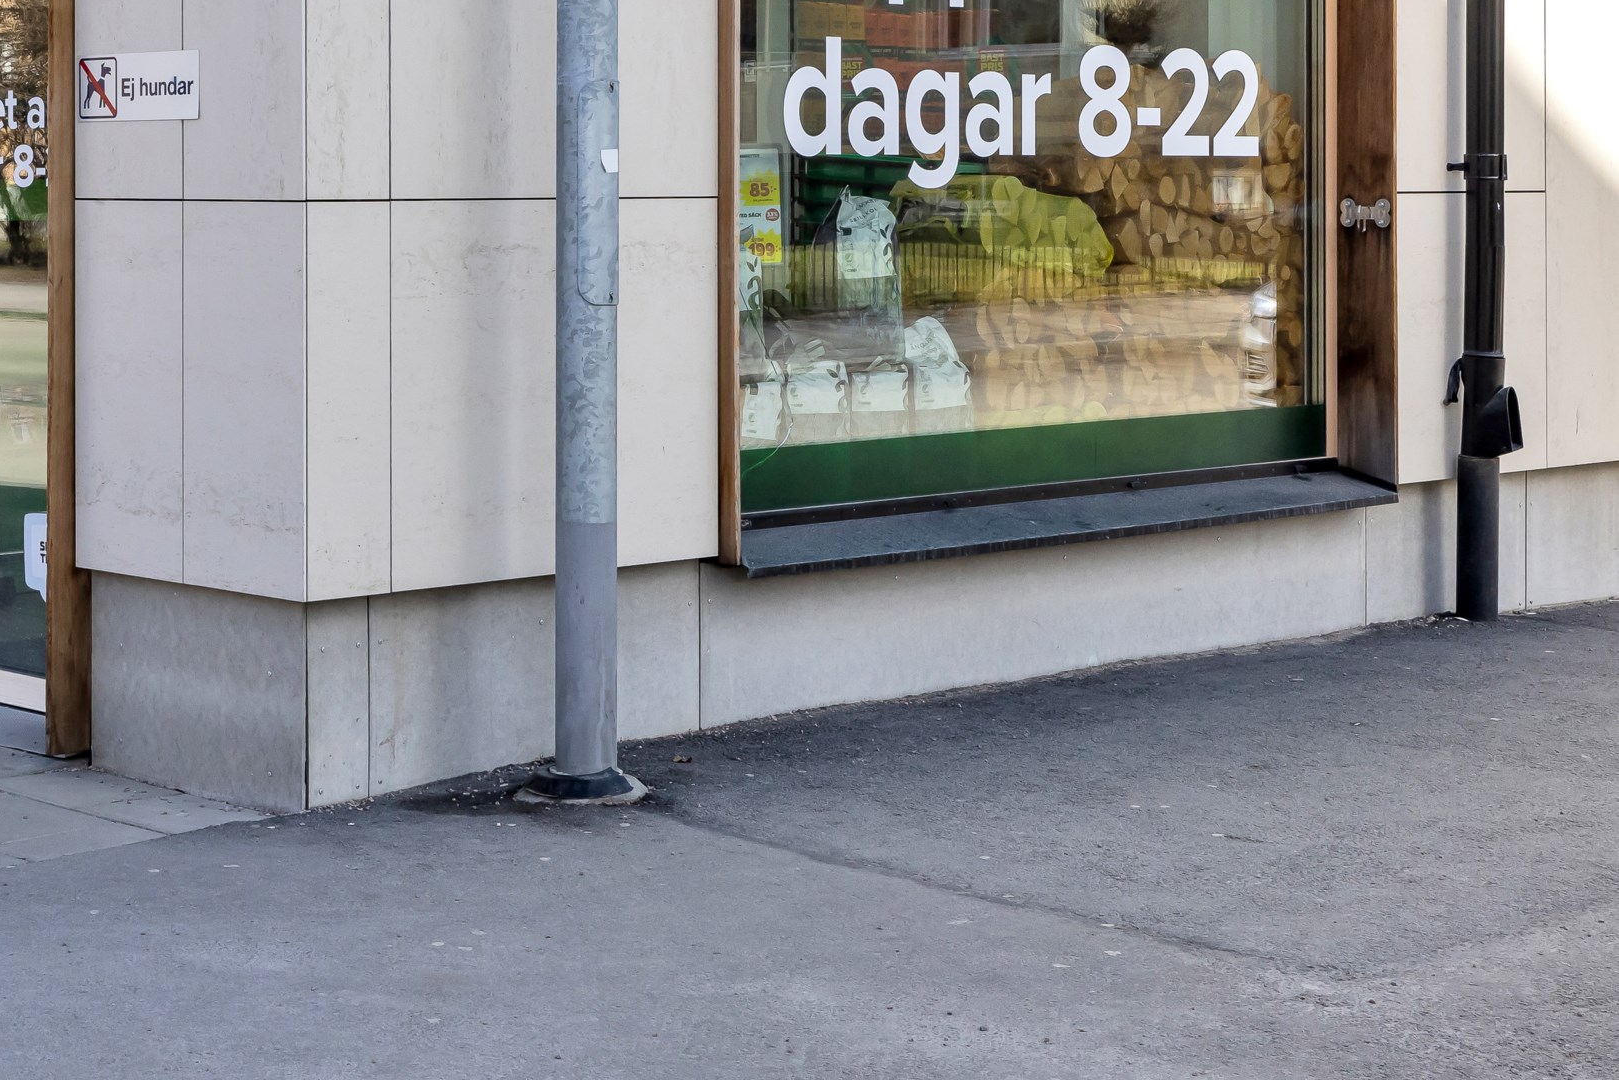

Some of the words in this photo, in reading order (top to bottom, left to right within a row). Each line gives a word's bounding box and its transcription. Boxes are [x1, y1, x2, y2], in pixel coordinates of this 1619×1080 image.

[27, 86, 49, 129] a
[121, 78, 135, 101] Ej
[140, 76, 194, 97] hundar
[783, 36, 1052, 189] dagar
[1078, 44, 1260, 159] 8-22
[13, 144, 49, 188] 8-
